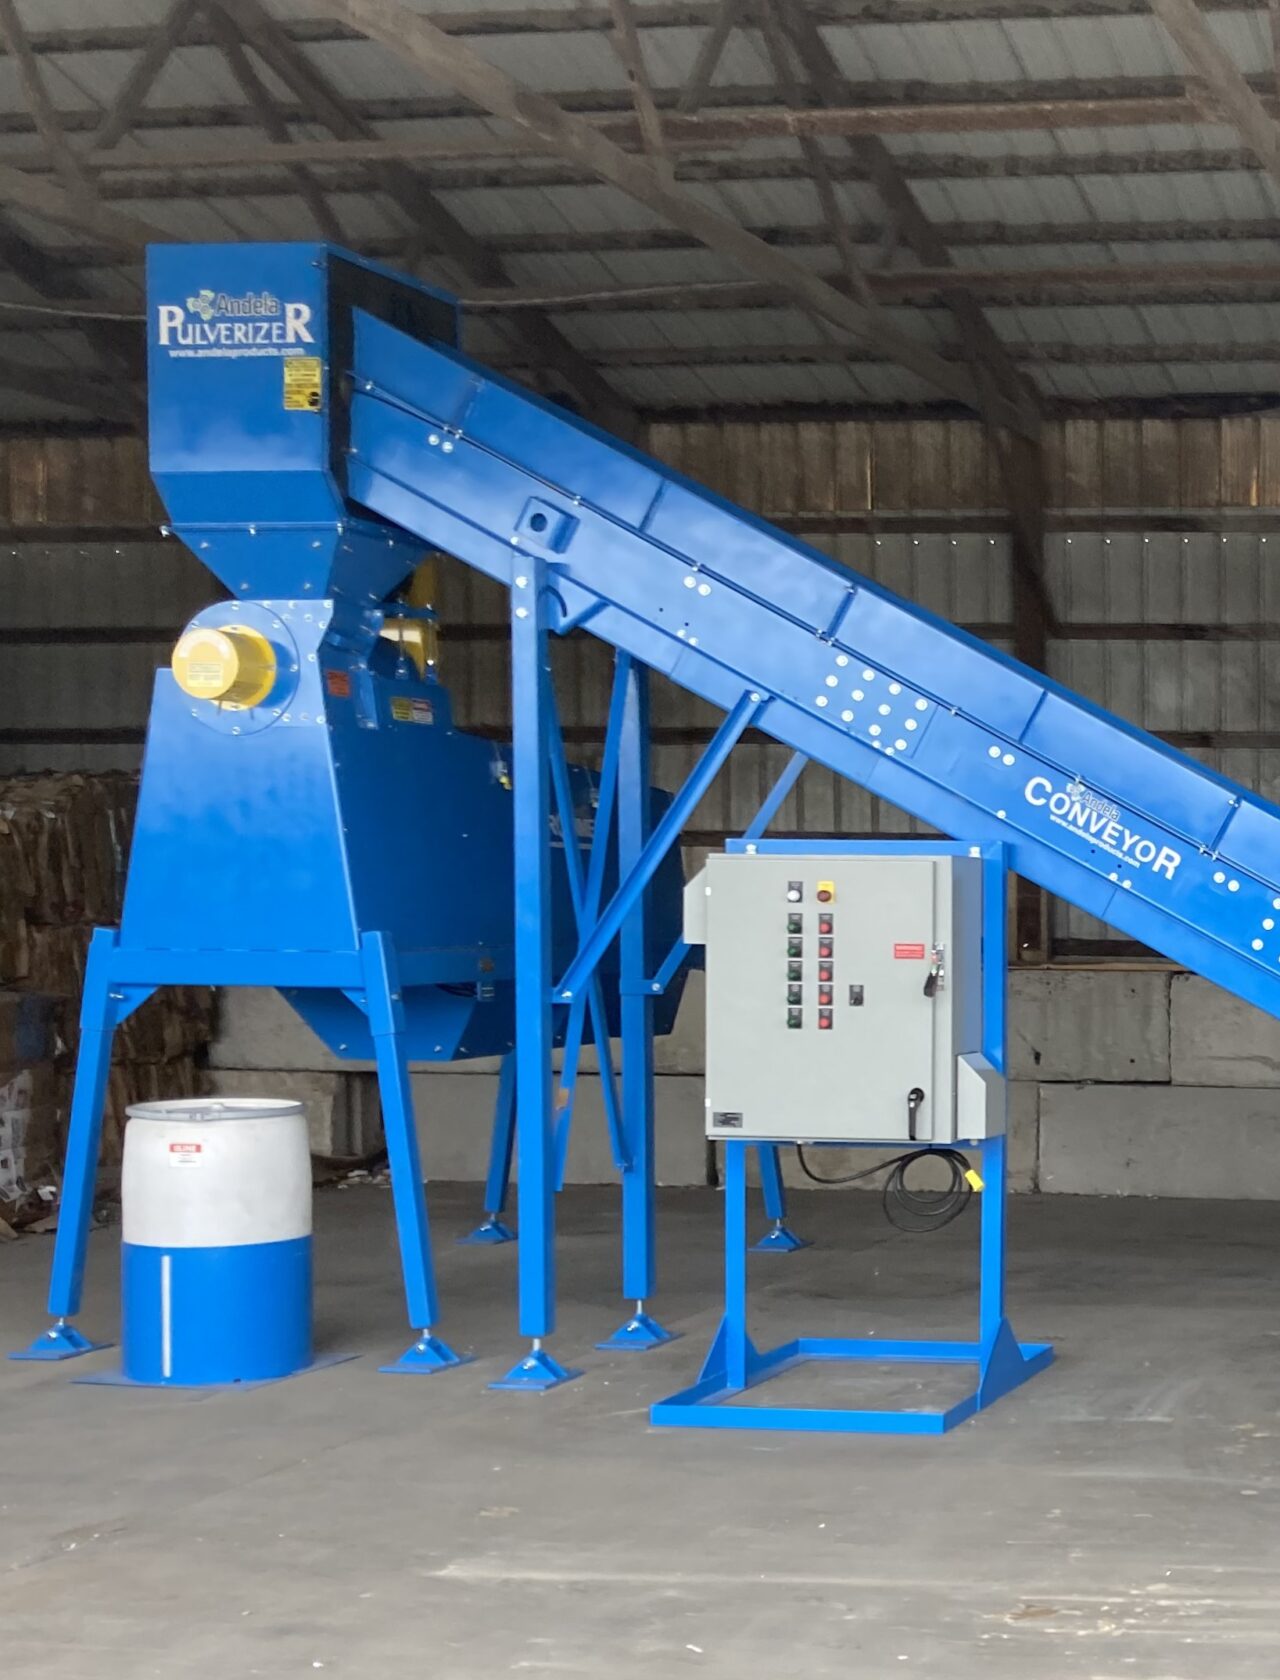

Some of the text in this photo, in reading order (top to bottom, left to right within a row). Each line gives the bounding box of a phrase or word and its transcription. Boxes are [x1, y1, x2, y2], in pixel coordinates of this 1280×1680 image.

[215, 292, 280, 316] Andela
[158, 303, 315, 345] PULVERIZER
[1082, 791, 1121, 822] Andela
[1024, 776, 1182, 881] CONVEYOR
